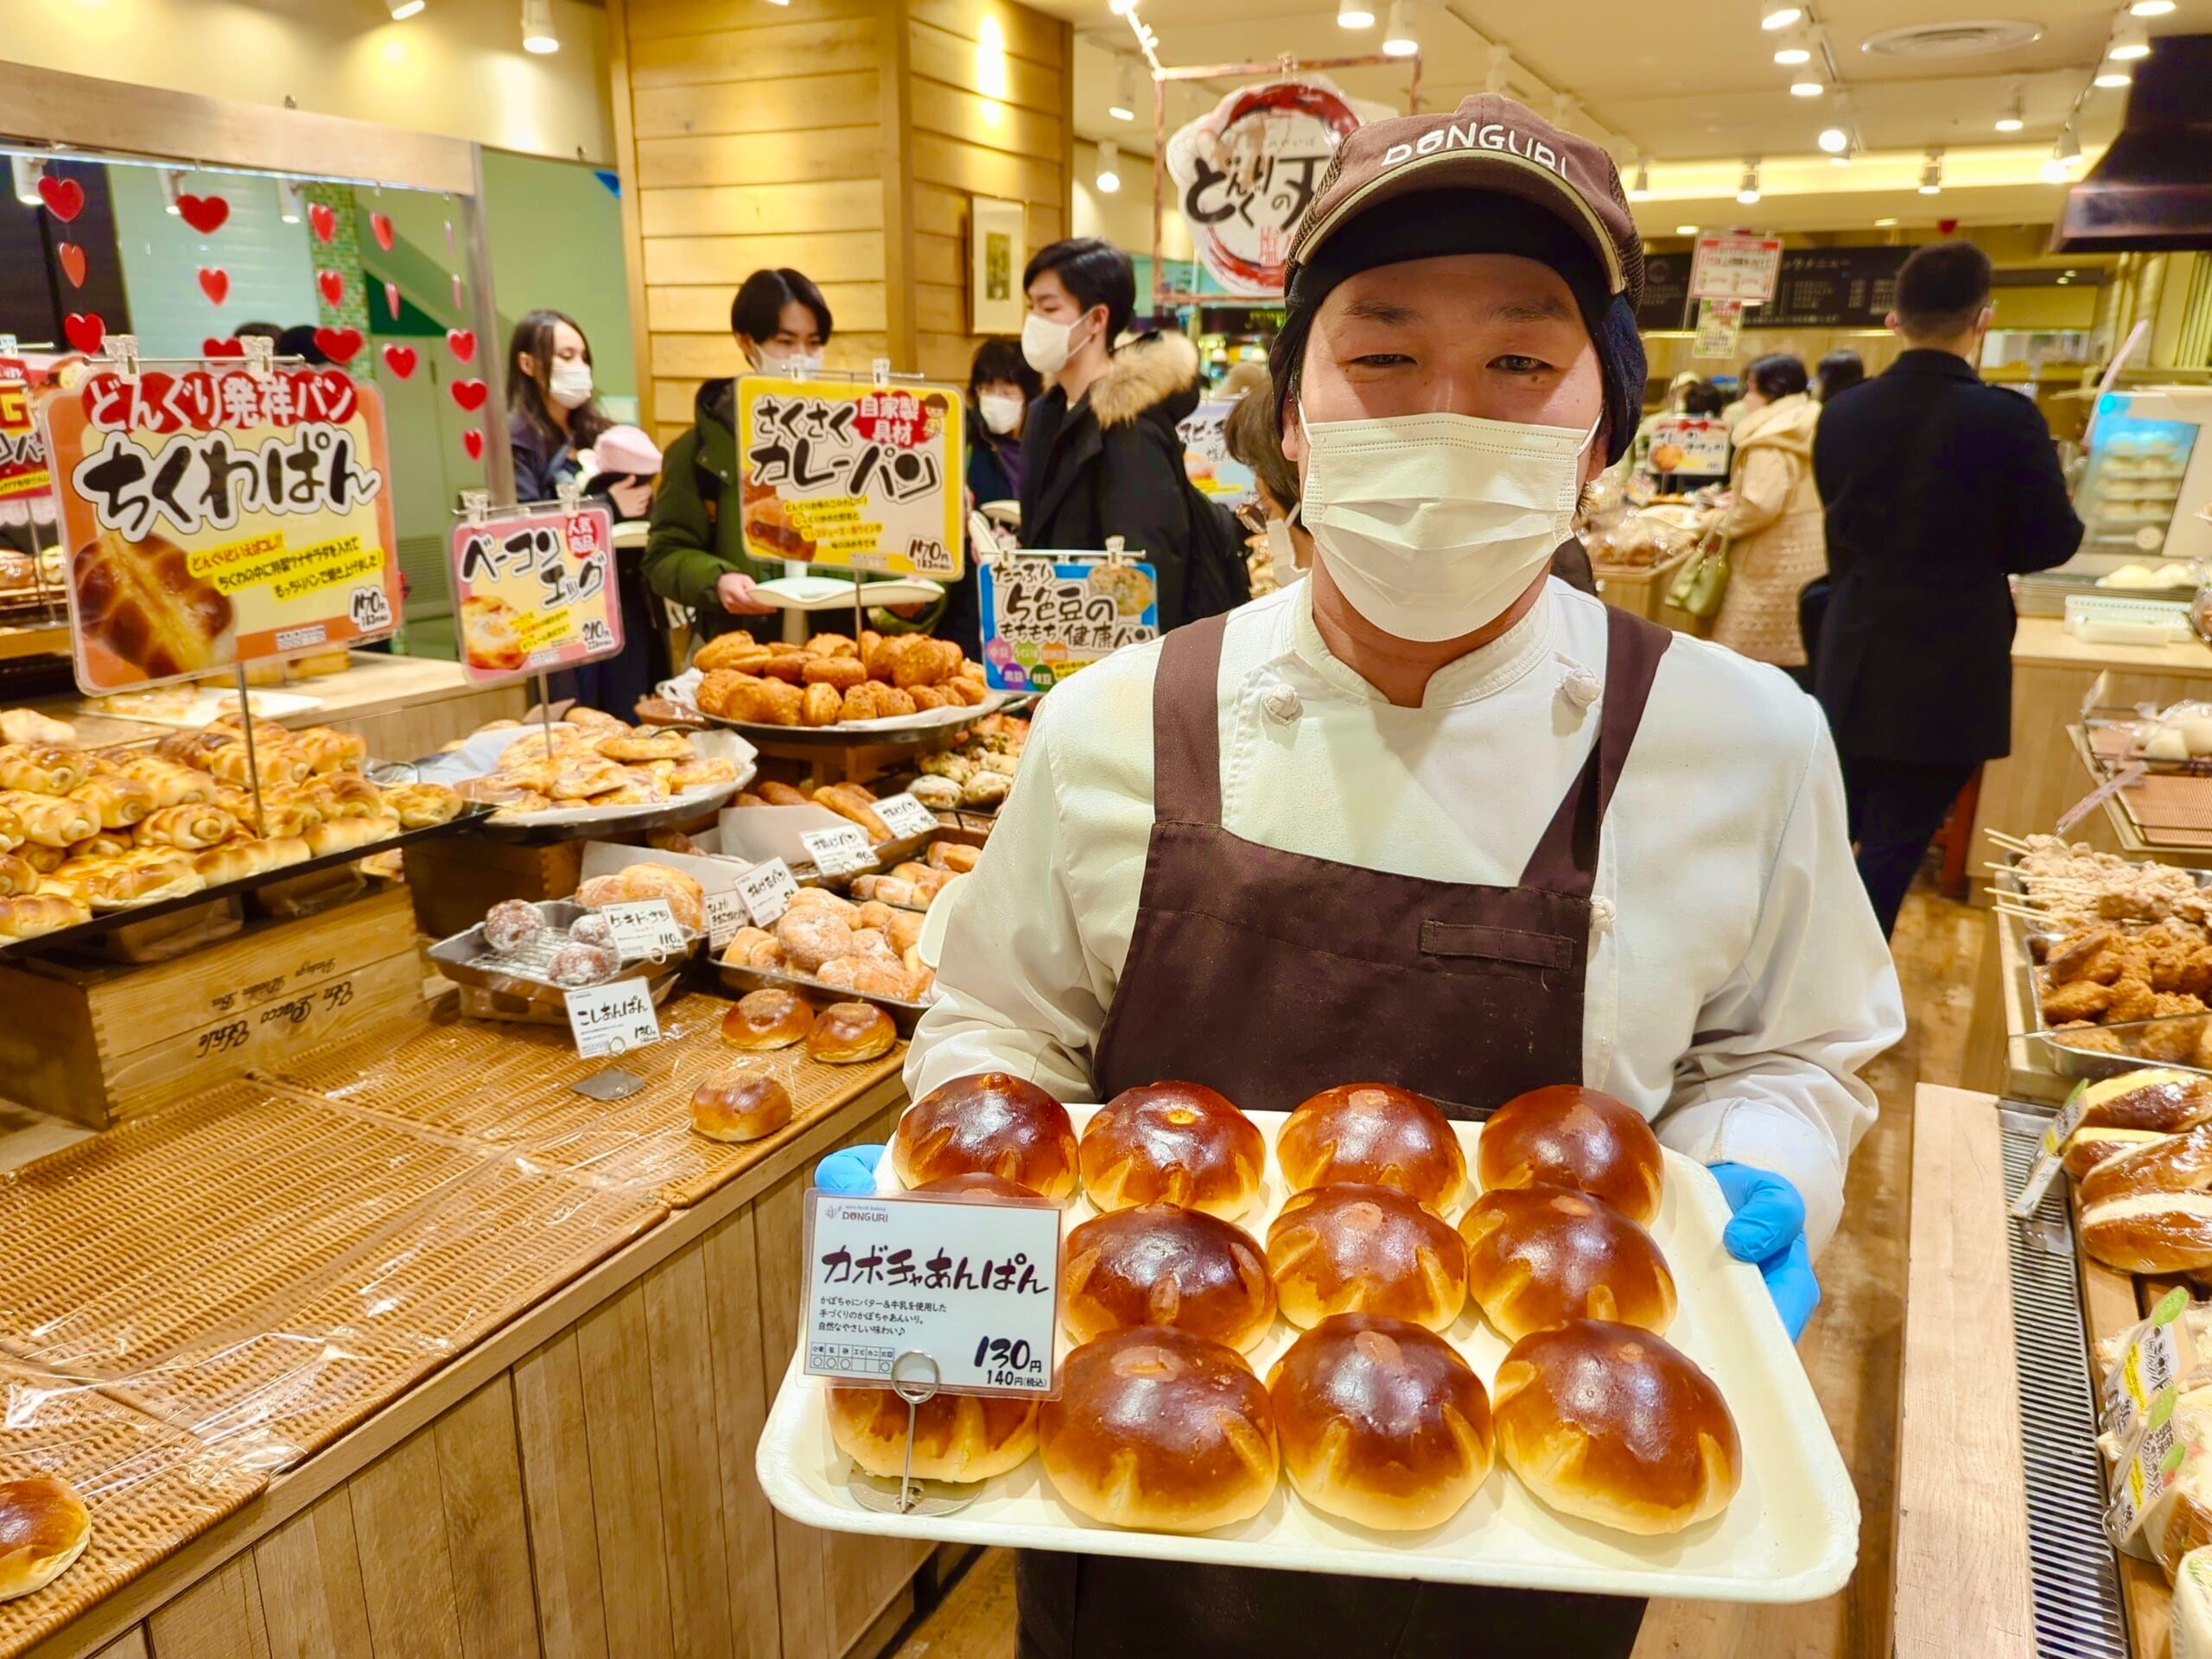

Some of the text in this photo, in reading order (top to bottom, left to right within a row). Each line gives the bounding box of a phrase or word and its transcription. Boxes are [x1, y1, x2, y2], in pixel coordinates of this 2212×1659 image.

[1381, 122, 1567, 181] DONGURI
[89, 375, 353, 432] どんぐり発祥パン
[861, 396, 919, 422] 自家製
[757, 399, 855, 443] さくさく
[873, 421, 913, 445] 具材
[83, 431, 377, 532] ちくわぱん
[750, 435, 938, 499] カレーパン
[567, 517, 593, 537] 人気
[462, 530, 561, 579] ベーコン
[570, 535, 596, 555] 商品
[910, 539, 949, 562] 170円
[541, 554, 605, 605] エッグ
[993, 562, 1052, 584] たっぷり
[1007, 583, 1114, 622] 5色豆の
[577, 995, 648, 1026] こしあんぱん
[842, 1211, 888, 1223] DONGURI
[821, 1244, 1049, 1294] カボチャあんぱん
[819, 1309, 924, 1325] 手づくりのかぼちゃあんいり。
[975, 1336, 1042, 1373] 130円
[987, 1370, 1047, 1388] 140円(税込)
